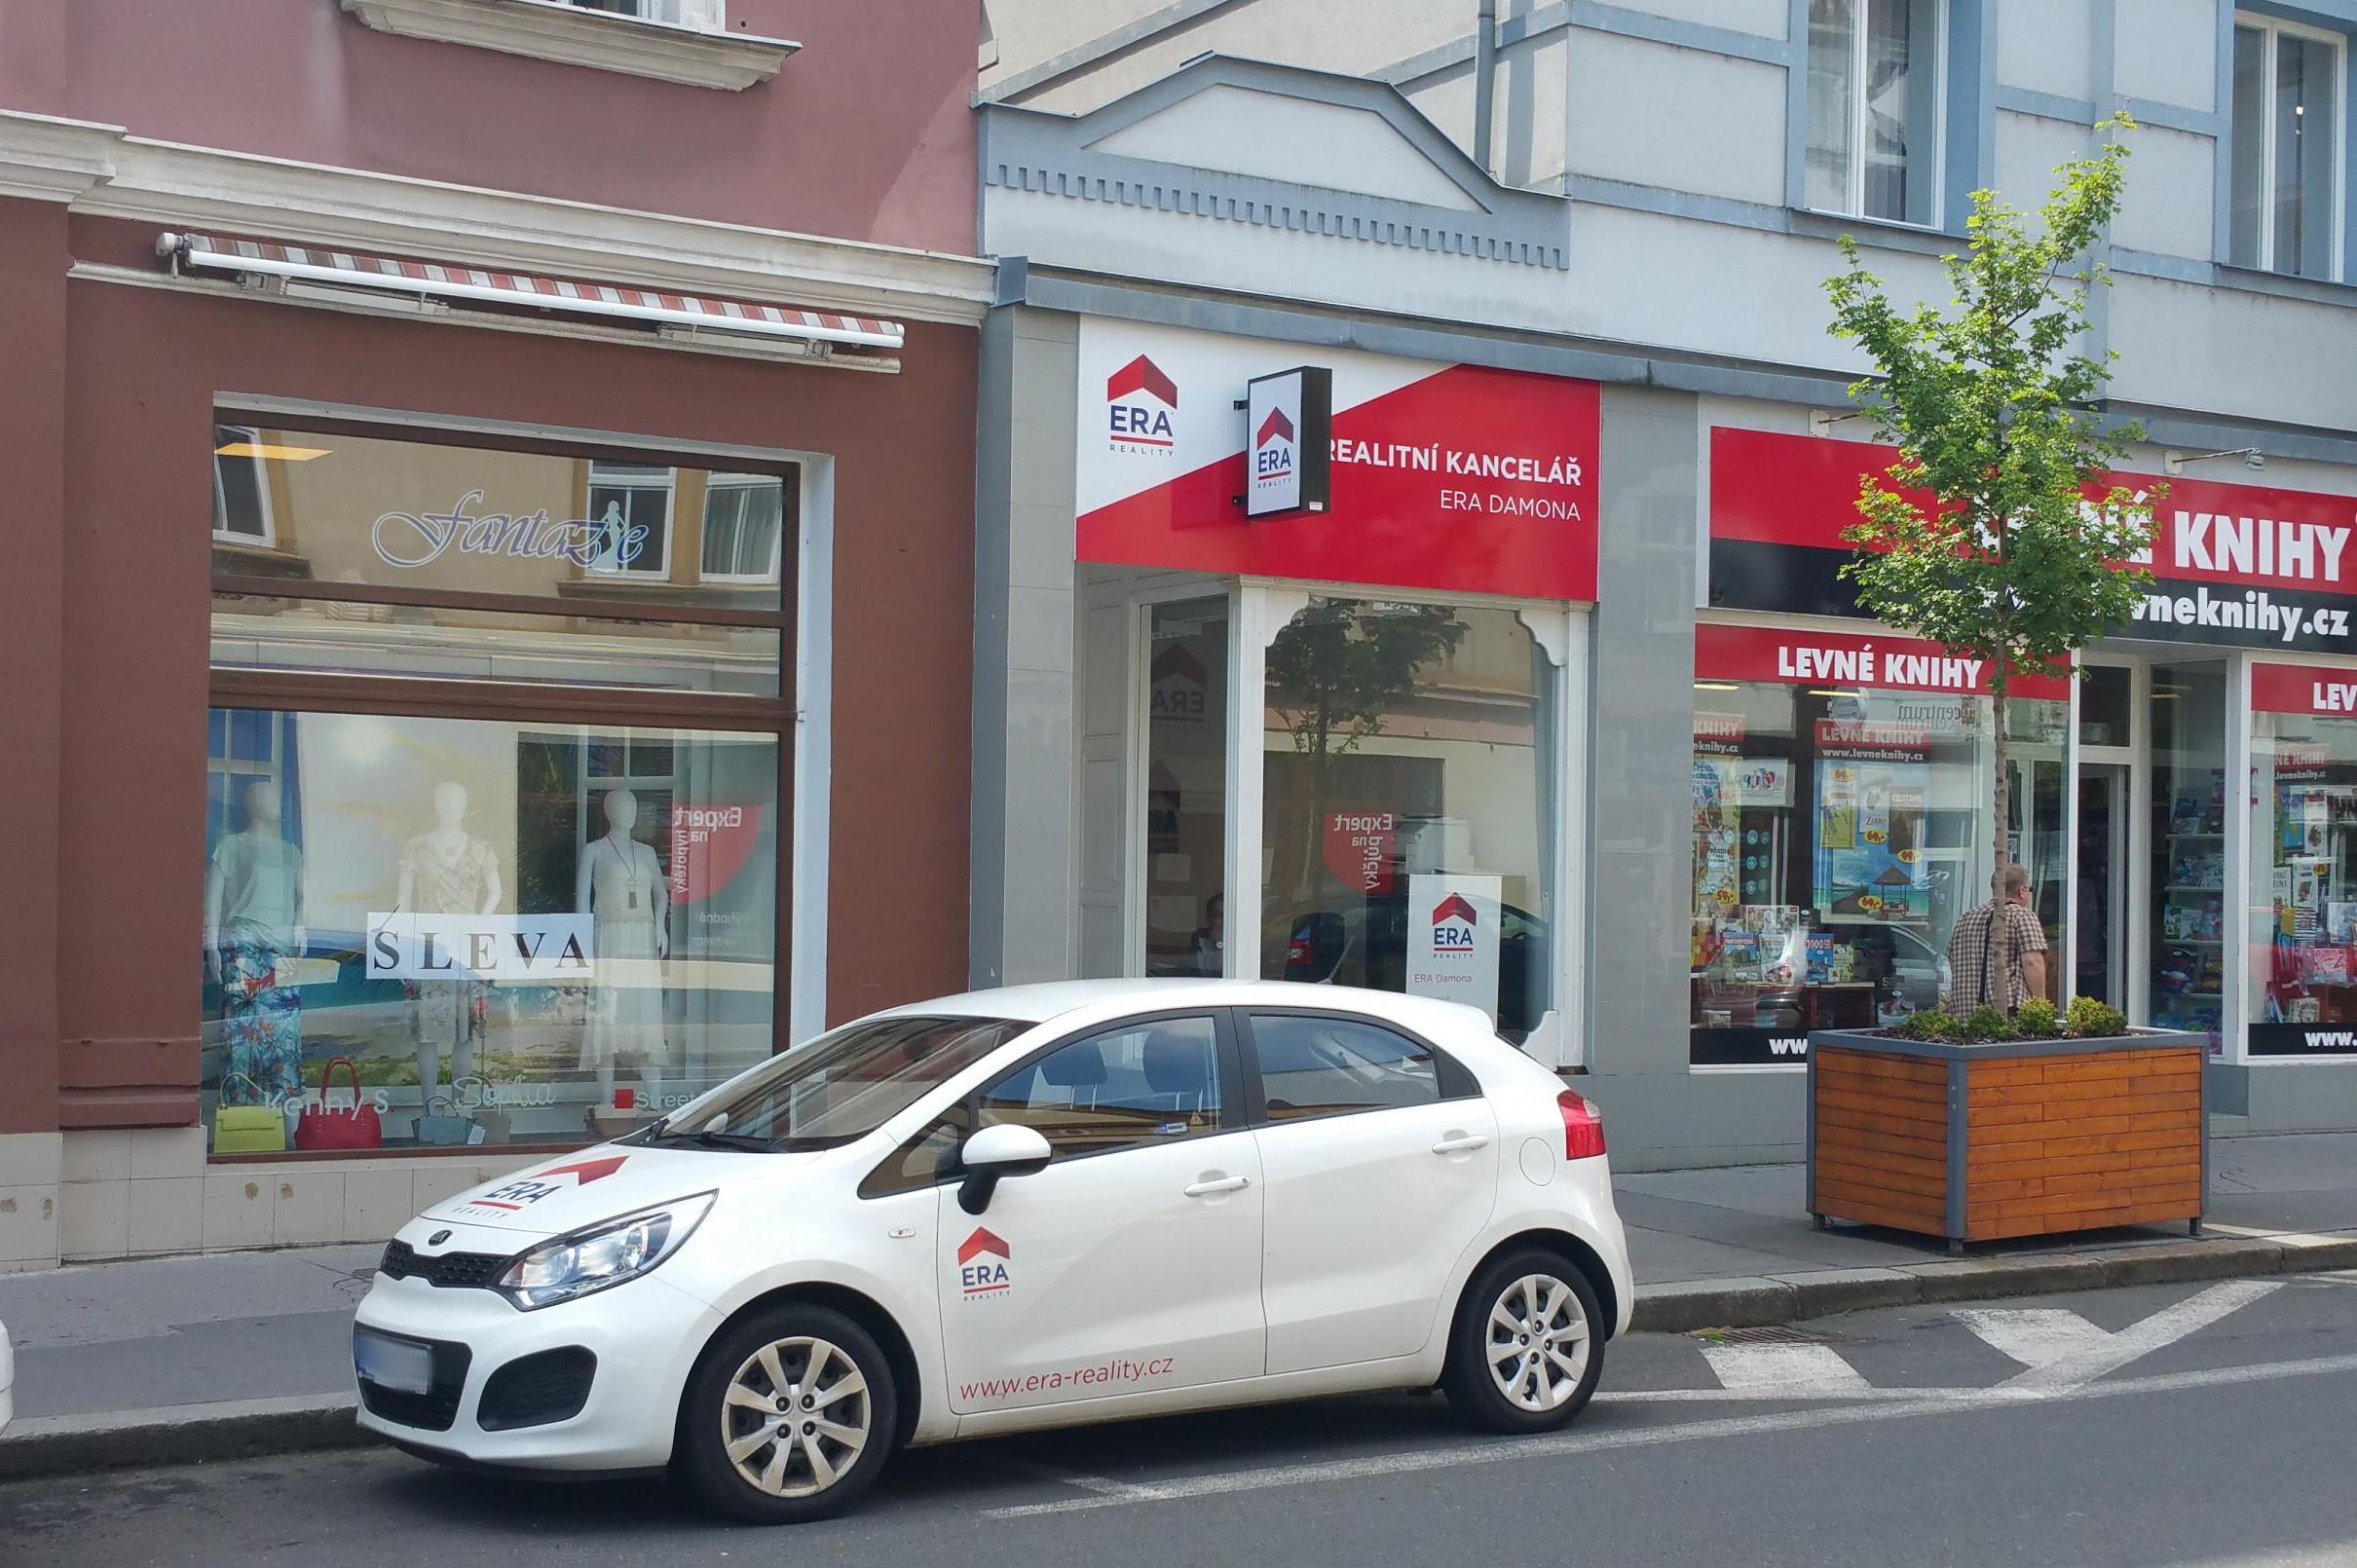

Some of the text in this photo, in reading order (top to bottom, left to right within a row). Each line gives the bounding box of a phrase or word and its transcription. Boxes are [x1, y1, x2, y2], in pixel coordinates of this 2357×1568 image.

[1109, 404, 1174, 436] ERA
[1109, 443, 1174, 458] REALITY
[1257, 447, 1291, 473] ERA
[1446, 450, 1582, 486] KANCELÁŘ
[1257, 478, 1292, 489] REALITY
[1440, 489, 1582, 521] ERA DAMONA
[2174, 509, 2351, 582] KNIHY
[1778, 643, 1983, 689] LEVNÉ KNIHY
[1822, 747, 1924, 763] www.levneknihy.cz
[1434, 927, 1474, 945] ERA
[373, 930, 590, 970] SLEVA
[1414, 974, 1472, 983] ERA Damona
[264, 1090, 364, 1121] Kenny
[484, 1180, 563, 1204] ERA
[452, 1207, 509, 1218] REALITY
[961, 1263, 1009, 1287] ERA
[963, 1290, 1011, 1302] REALITY
[960, 1357, 1175, 1400] www.era-reality.cz
